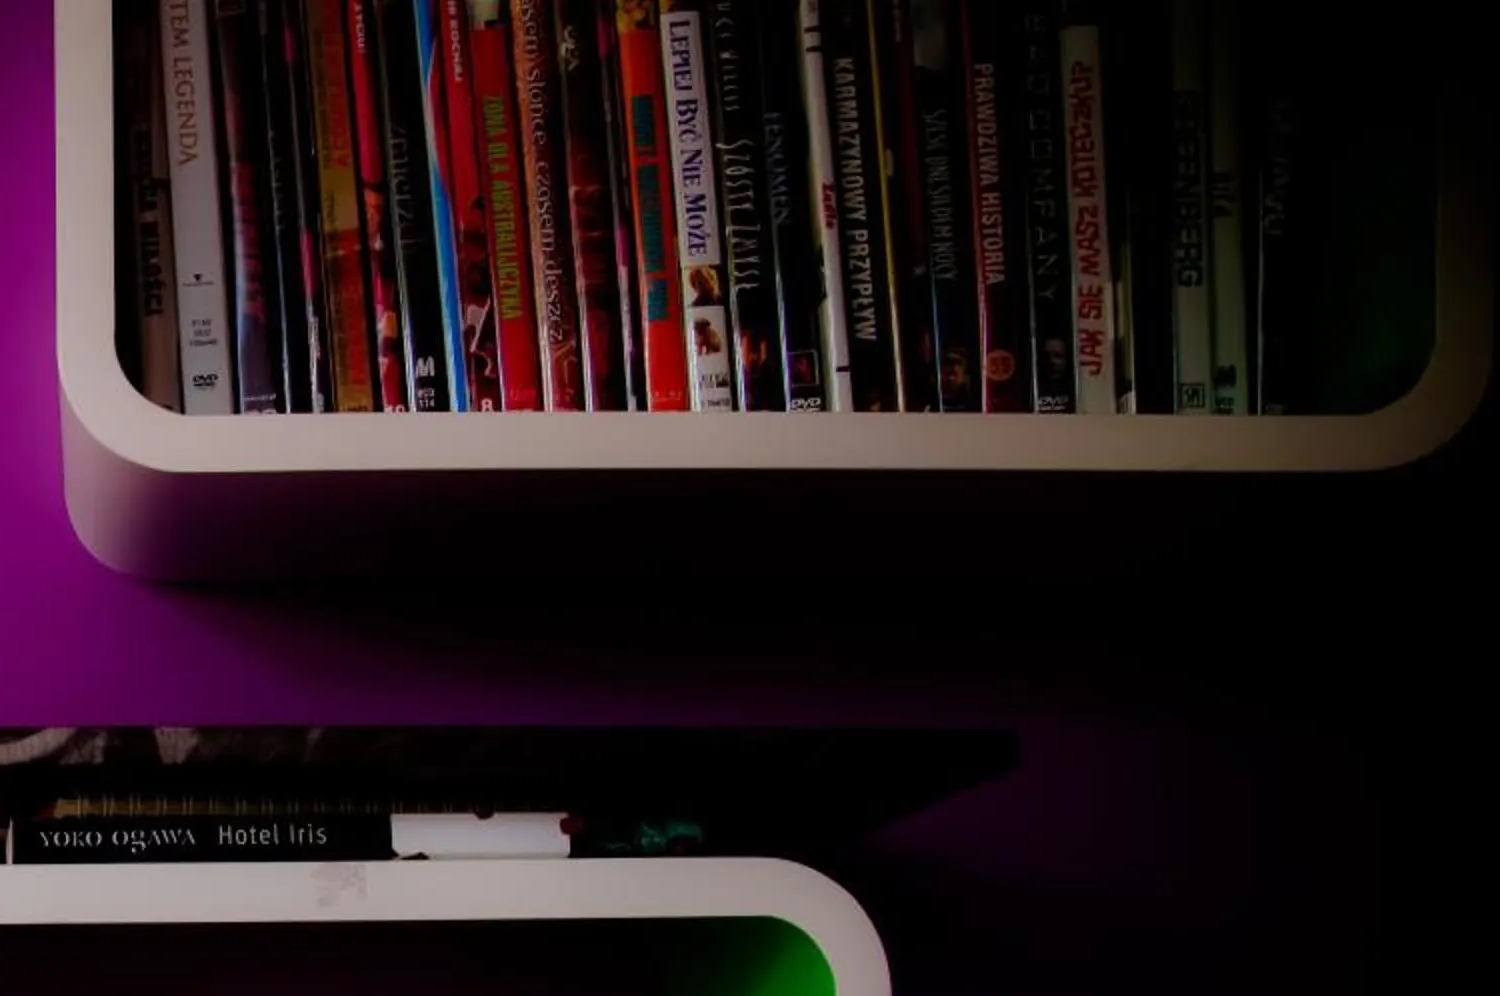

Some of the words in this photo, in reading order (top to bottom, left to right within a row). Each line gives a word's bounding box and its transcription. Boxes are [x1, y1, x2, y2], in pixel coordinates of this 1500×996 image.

[669, 20, 696, 91] LEPIEJ
[172, 57, 199, 166] LEGENDA
[833, 56, 868, 220] KARMAZYNOWY
[973, 62, 999, 187] PRAWDZIWA
[980, 192, 1006, 286] HISTORIA
[1028, 106, 1062, 303] COMPANY
[1075, 206, 1102, 283] MASZ
[845, 229, 877, 342] PRZYPŁYW
[1078, 329, 1106, 378] JAK
[218, 822, 280, 846] Hotel
[289, 822, 329, 846] Iris
